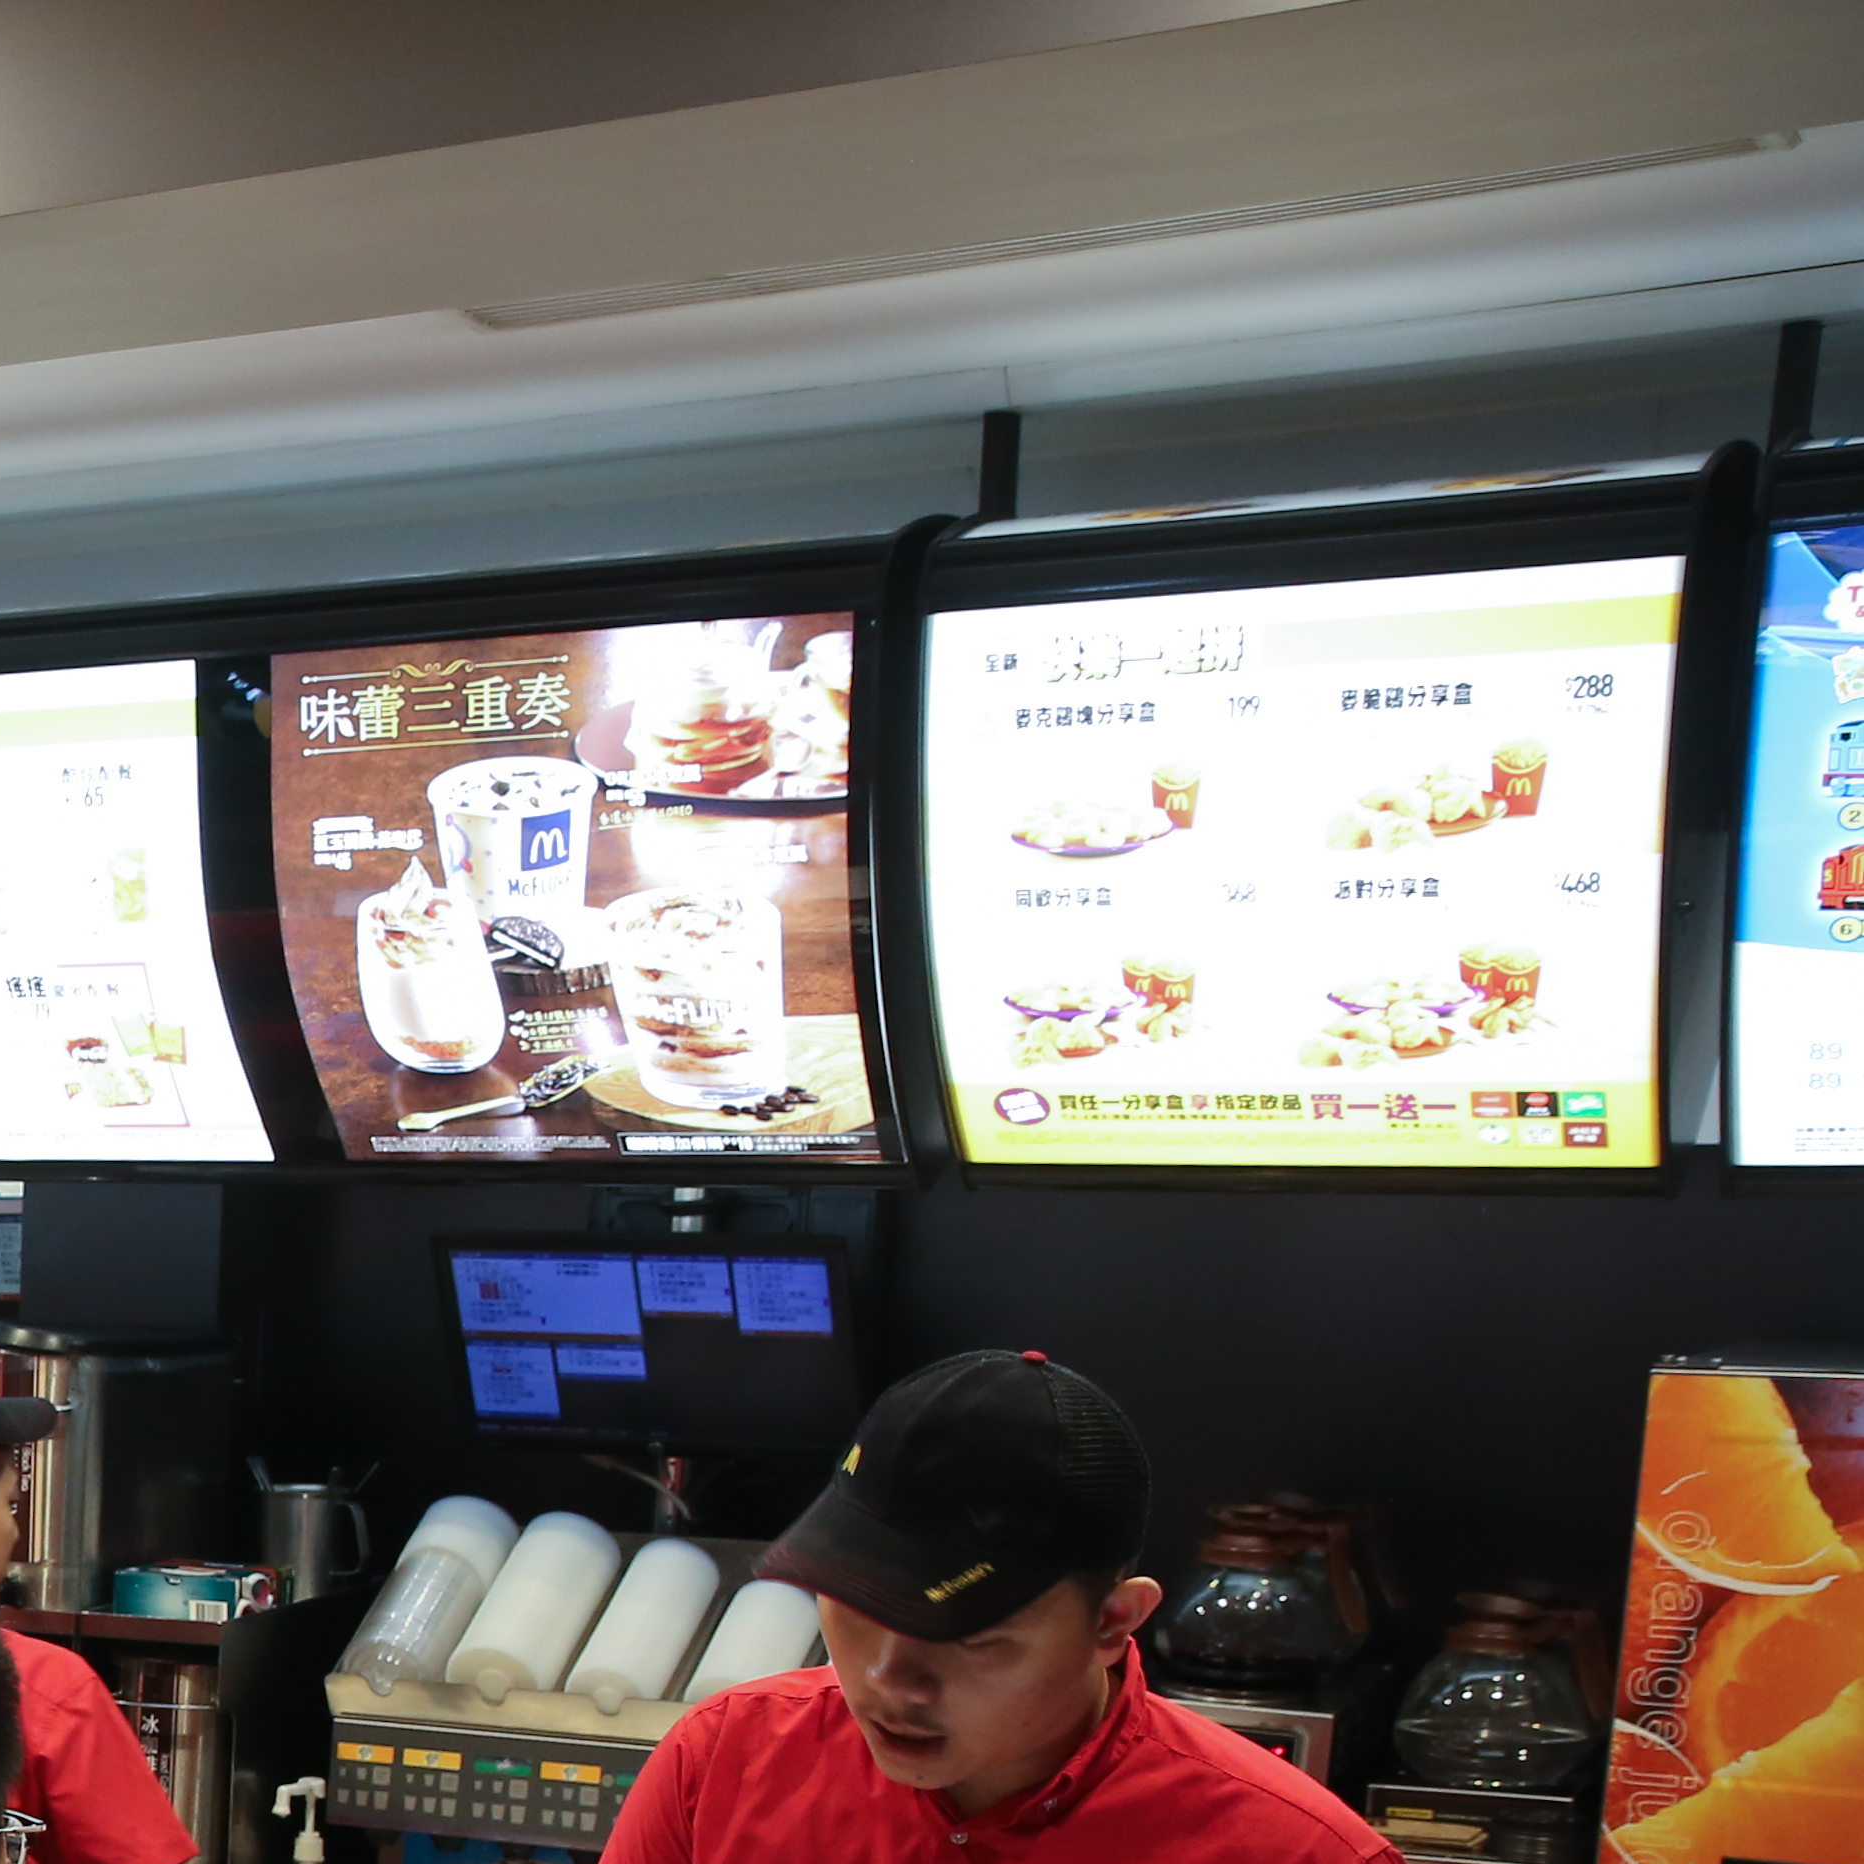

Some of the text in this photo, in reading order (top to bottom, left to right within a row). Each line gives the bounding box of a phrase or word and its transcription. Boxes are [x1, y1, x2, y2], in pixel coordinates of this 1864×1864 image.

[299, 669, 572, 742] 味蕾三重奏
[1311, 1094, 1457, 1120] 買一送一
